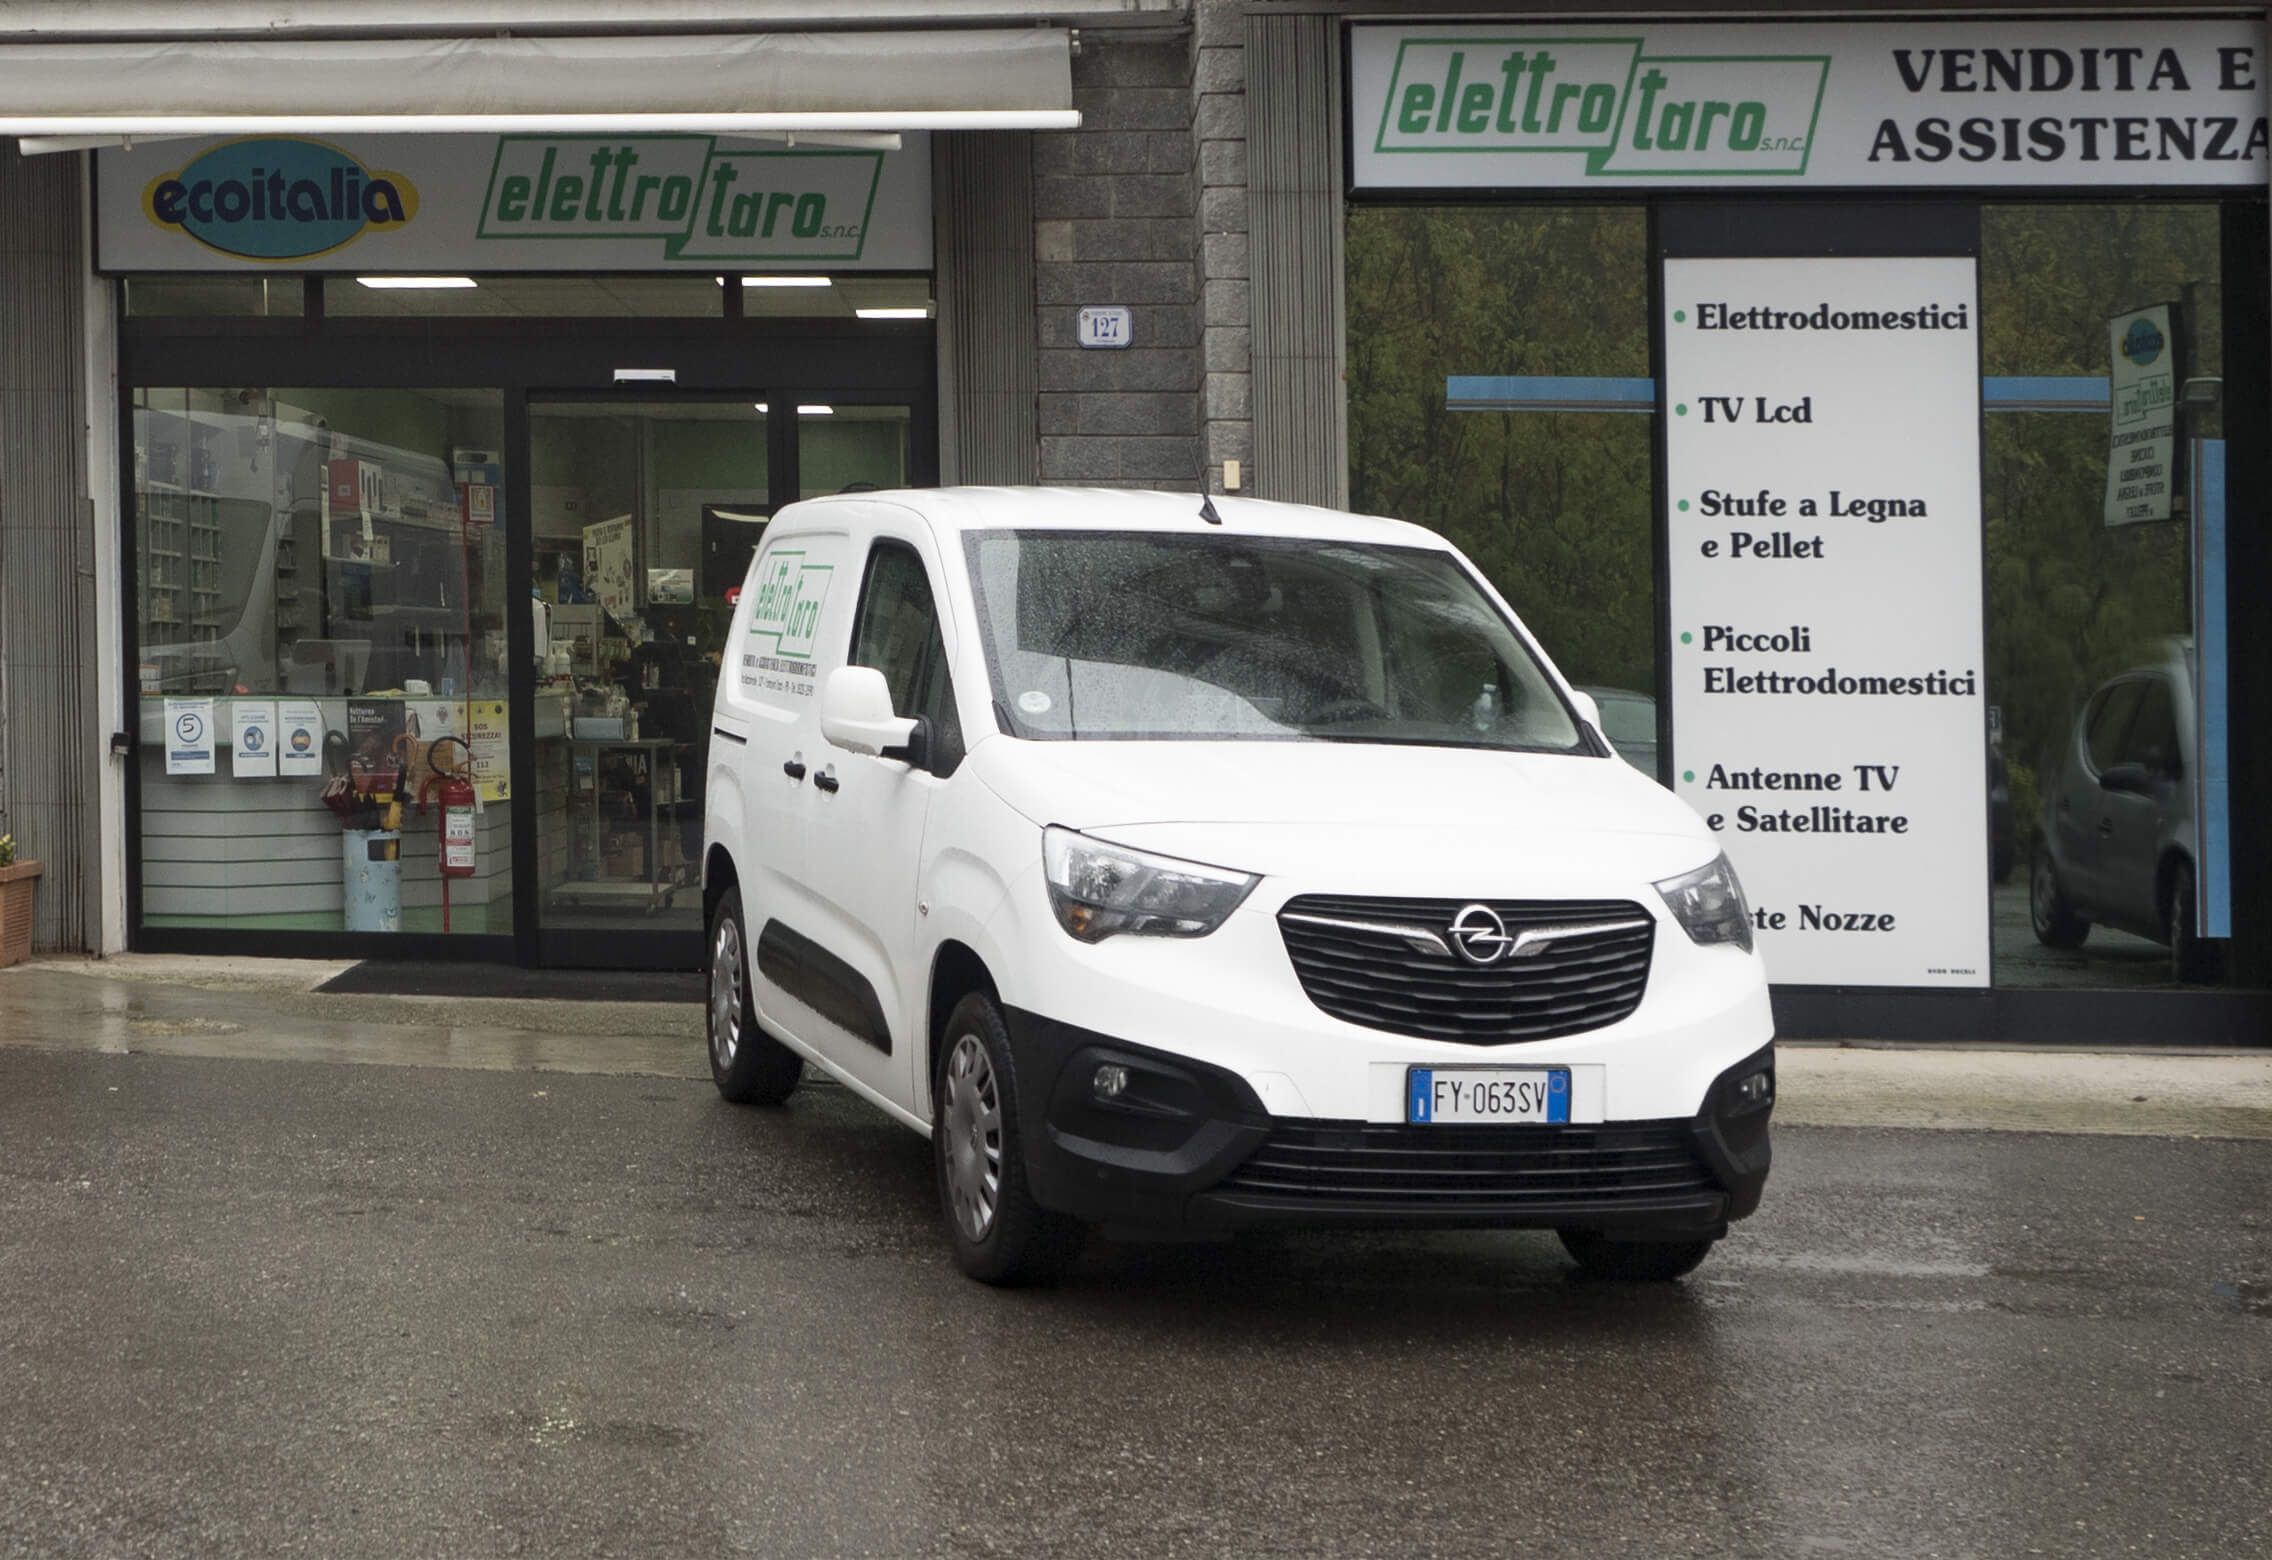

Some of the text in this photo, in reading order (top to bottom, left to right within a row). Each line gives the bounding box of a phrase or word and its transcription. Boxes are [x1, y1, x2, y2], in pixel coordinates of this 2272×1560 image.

[1893, 48, 2255, 92] VENDITA E
[1398, 51, 1805, 151] elettro taro s.n.c.
[1867, 117, 2268, 163] ASSISTENZA
[153, 168, 405, 224] ecoitalia
[497, 146, 861, 239] elettro taro s.n.c.
[1093, 317, 1119, 337] 127
[1696, 303, 1968, 330] Elettrodomestici
[1698, 397, 1813, 423] TV Lcd
[1700, 490, 1927, 523] Stufe a Legna
[1700, 532, 1824, 559] e Pellet
[1703, 626, 1811, 653] Piccoli
[1703, 668, 1976, 696] Elettrodomestici
[183, 717, 194, 733] 5
[1706, 764, 1900, 791] Antenne TV
[1707, 805, 1909, 834] e Satellitare
[1799, 905, 1896, 931] Nozze
